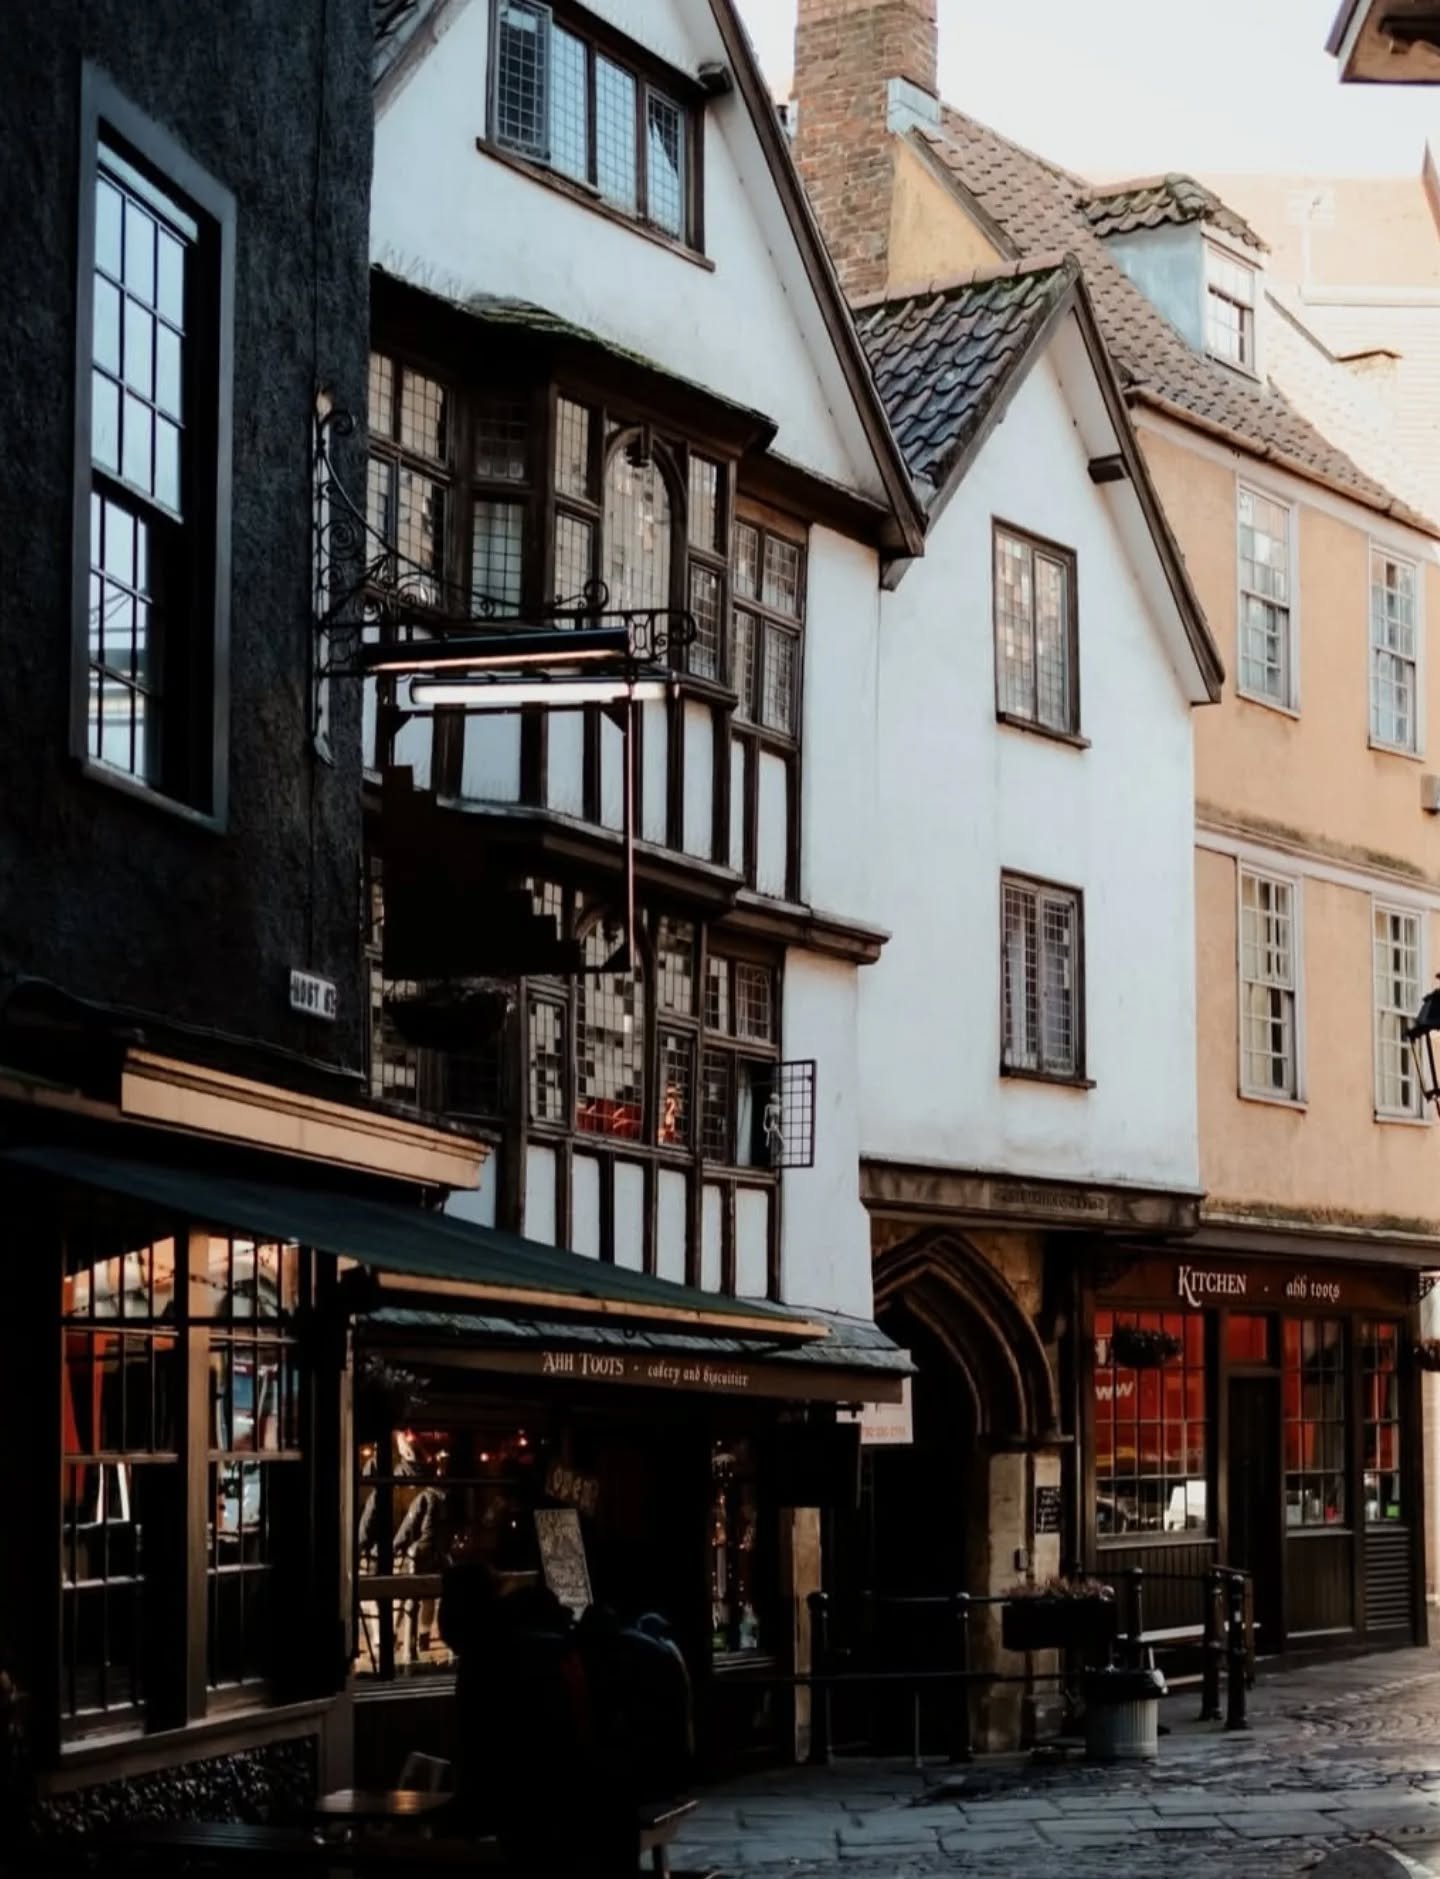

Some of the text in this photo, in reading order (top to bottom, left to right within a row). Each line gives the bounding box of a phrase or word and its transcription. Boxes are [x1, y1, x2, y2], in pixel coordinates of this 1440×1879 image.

[1178, 1264, 1247, 1308] KITCHEN
[1310, 1280, 1341, 1304] toots
[542, 1350, 574, 1374] AHH
[579, 1351, 625, 1376] TOOTS
[683, 1364, 701, 1382] and
